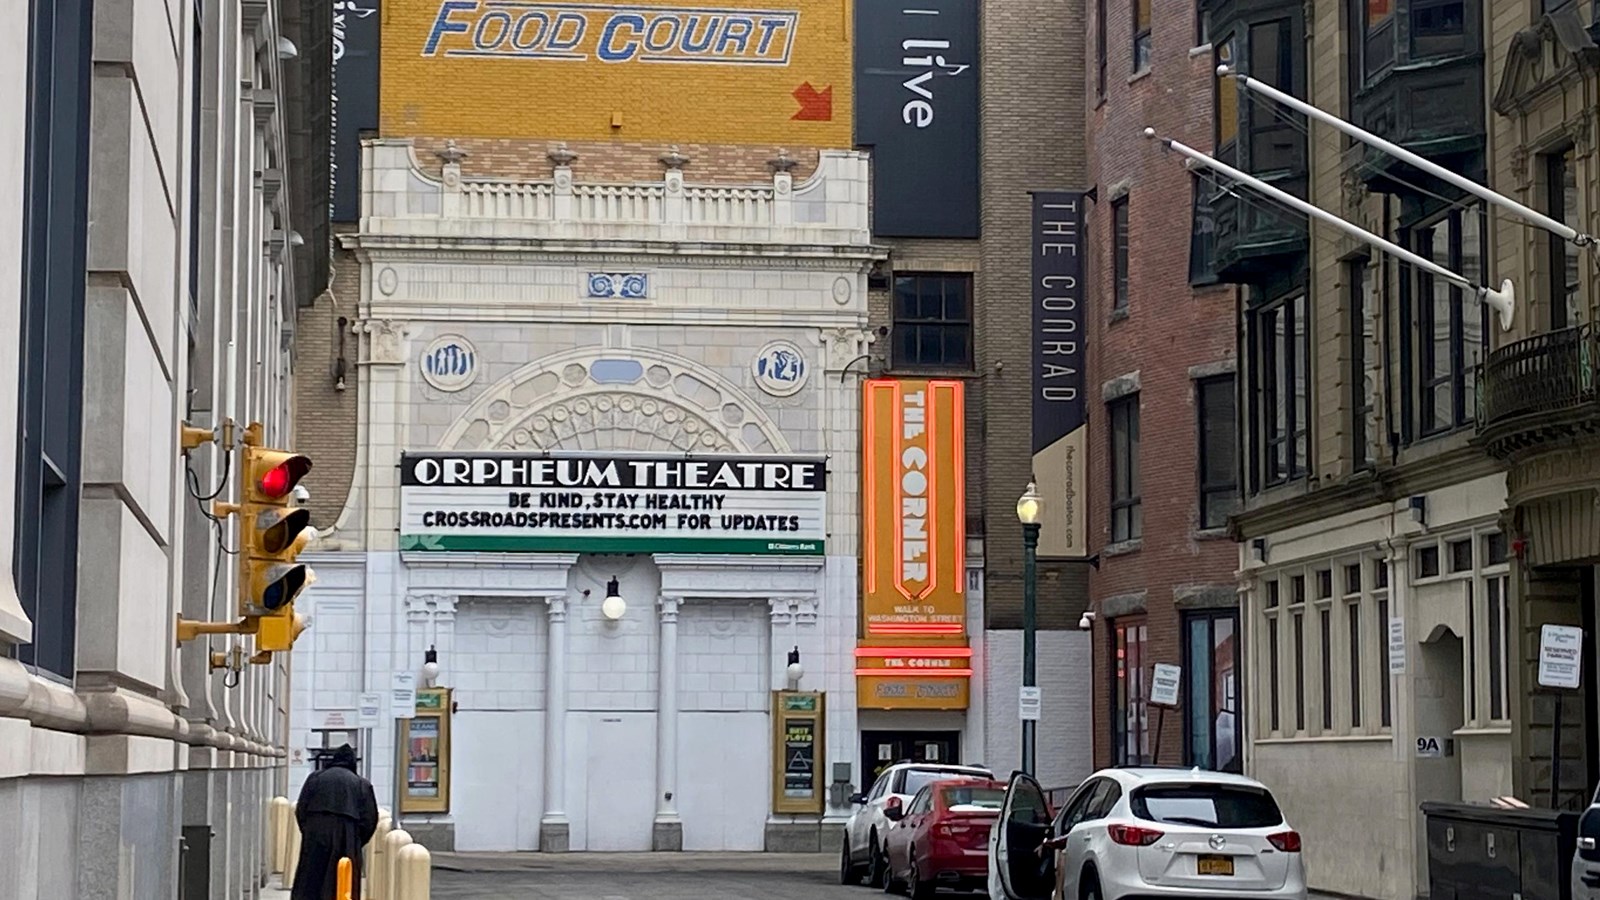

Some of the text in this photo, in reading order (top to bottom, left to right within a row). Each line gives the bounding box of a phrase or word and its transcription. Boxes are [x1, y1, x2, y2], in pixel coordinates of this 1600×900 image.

[421, 0, 788, 62] FOOD COURT
[903, 39, 949, 127] live
[1042, 200, 1076, 400] THE CONRAD
[414, 458, 815, 489] ORPHEUM THEATRE
[902, 390, 927, 582] THE CORNER
[508, 492, 531, 508] BE
[645, 493, 725, 510] HEALTHY
[423, 511, 799, 531] CROSSROADSPRESENTS.COM FOR UPDATES
[868, 614, 963, 623] WASHINGTON STREET
[894, 605, 935, 614] WALK TO
[1416, 737, 1439, 751] 9A
